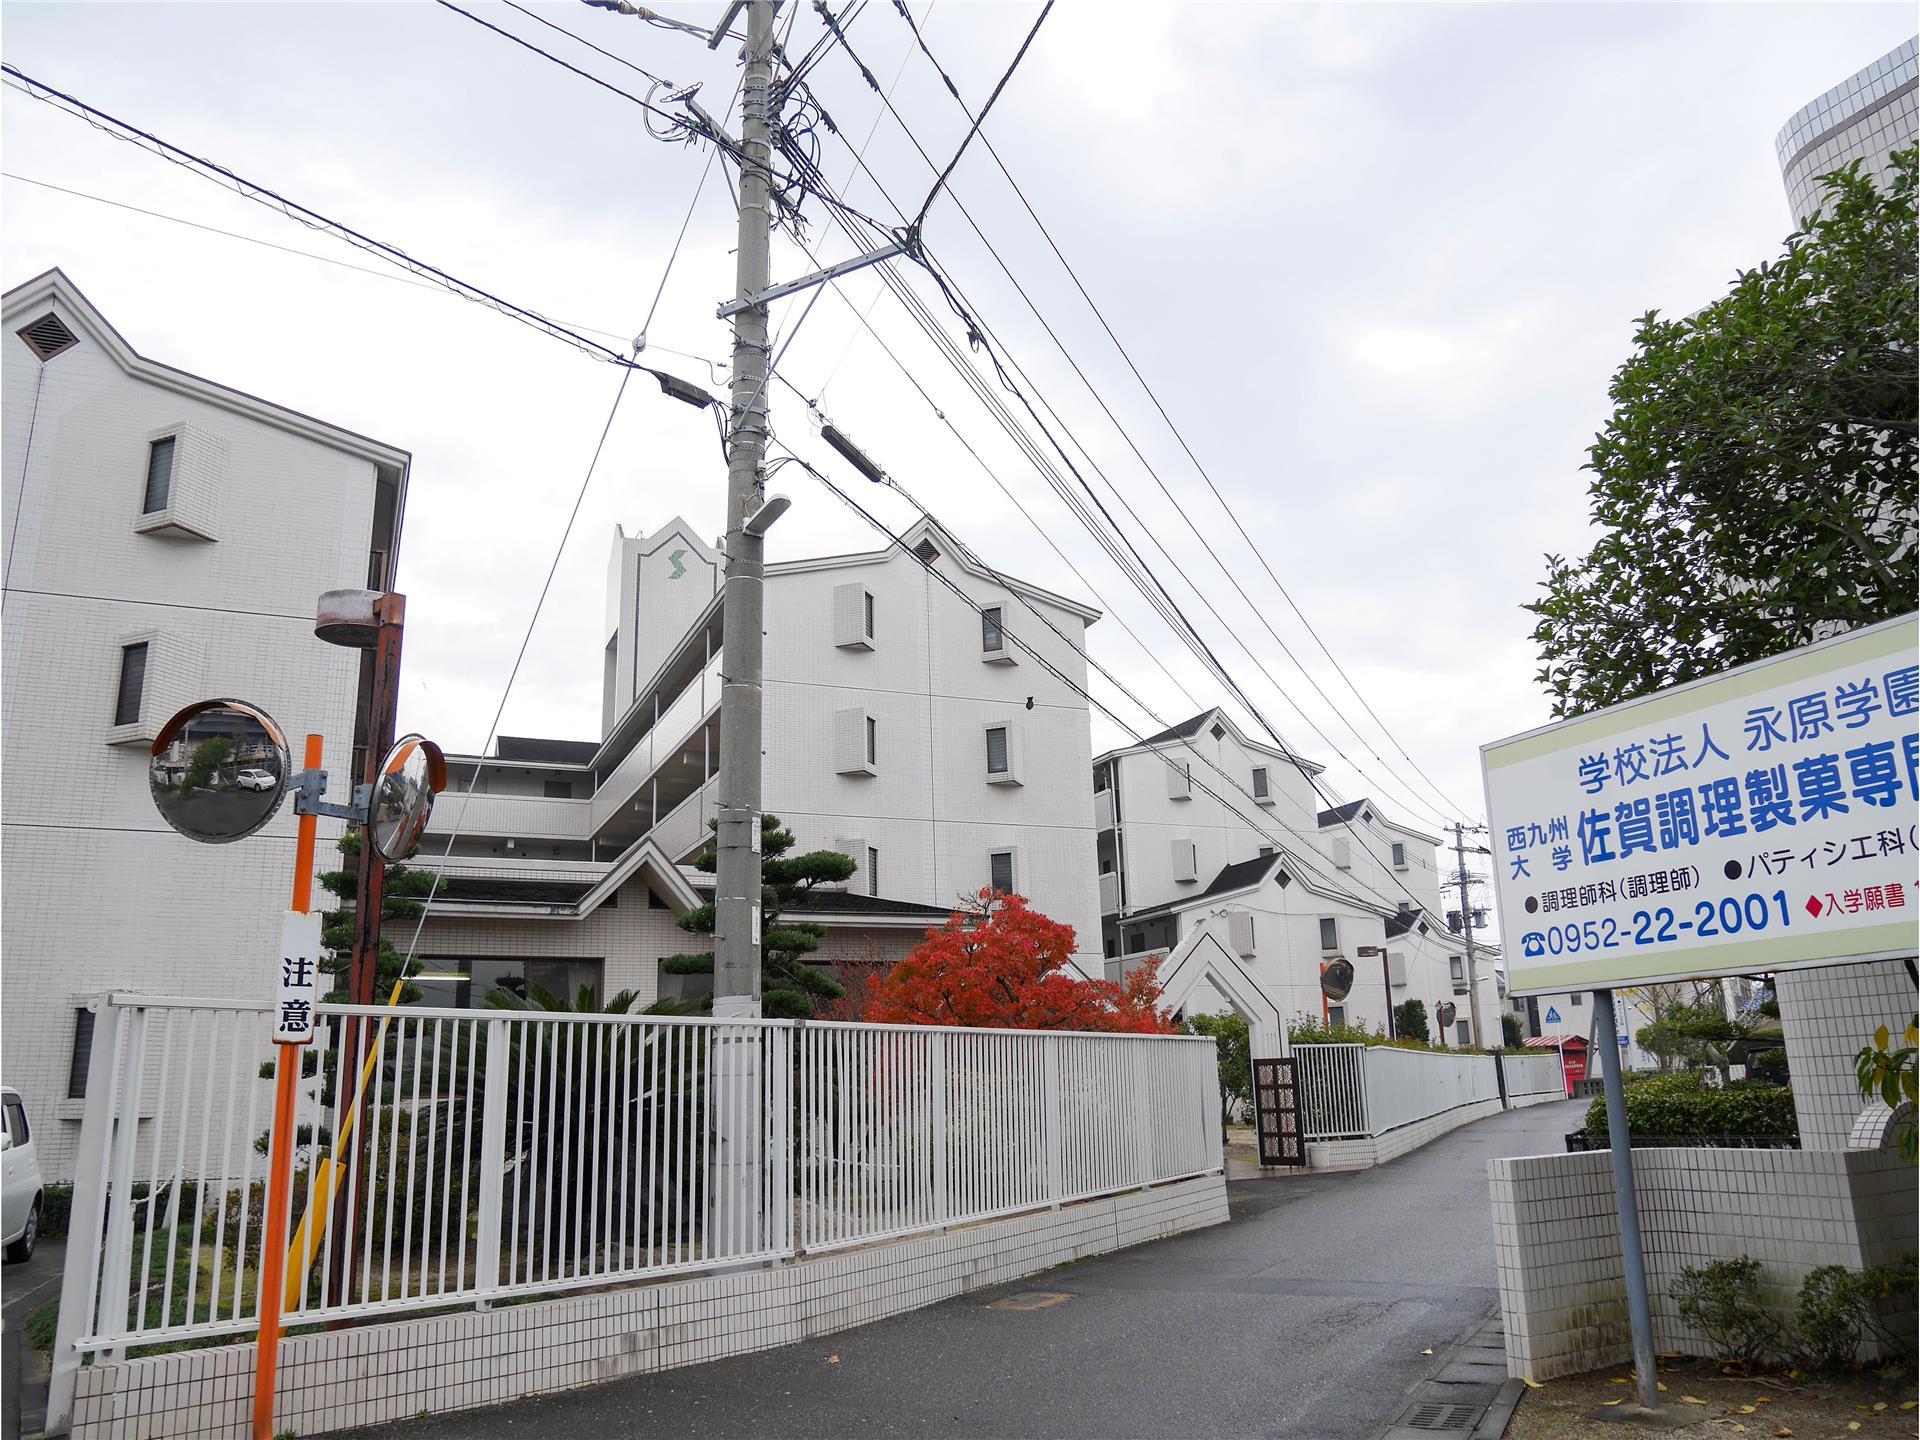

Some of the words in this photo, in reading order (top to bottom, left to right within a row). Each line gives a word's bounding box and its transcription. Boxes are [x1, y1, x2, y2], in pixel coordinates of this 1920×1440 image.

[1578, 722, 1730, 795] 学校法人
[1743, 664, 1919, 752] 永原学園
[1506, 815, 1570, 852] 西九州
[1547, 889, 1791, 956] 0952-22-2001
[1824, 882, 1906, 917] 入学願書
[278, 957, 315, 1033] 注意
